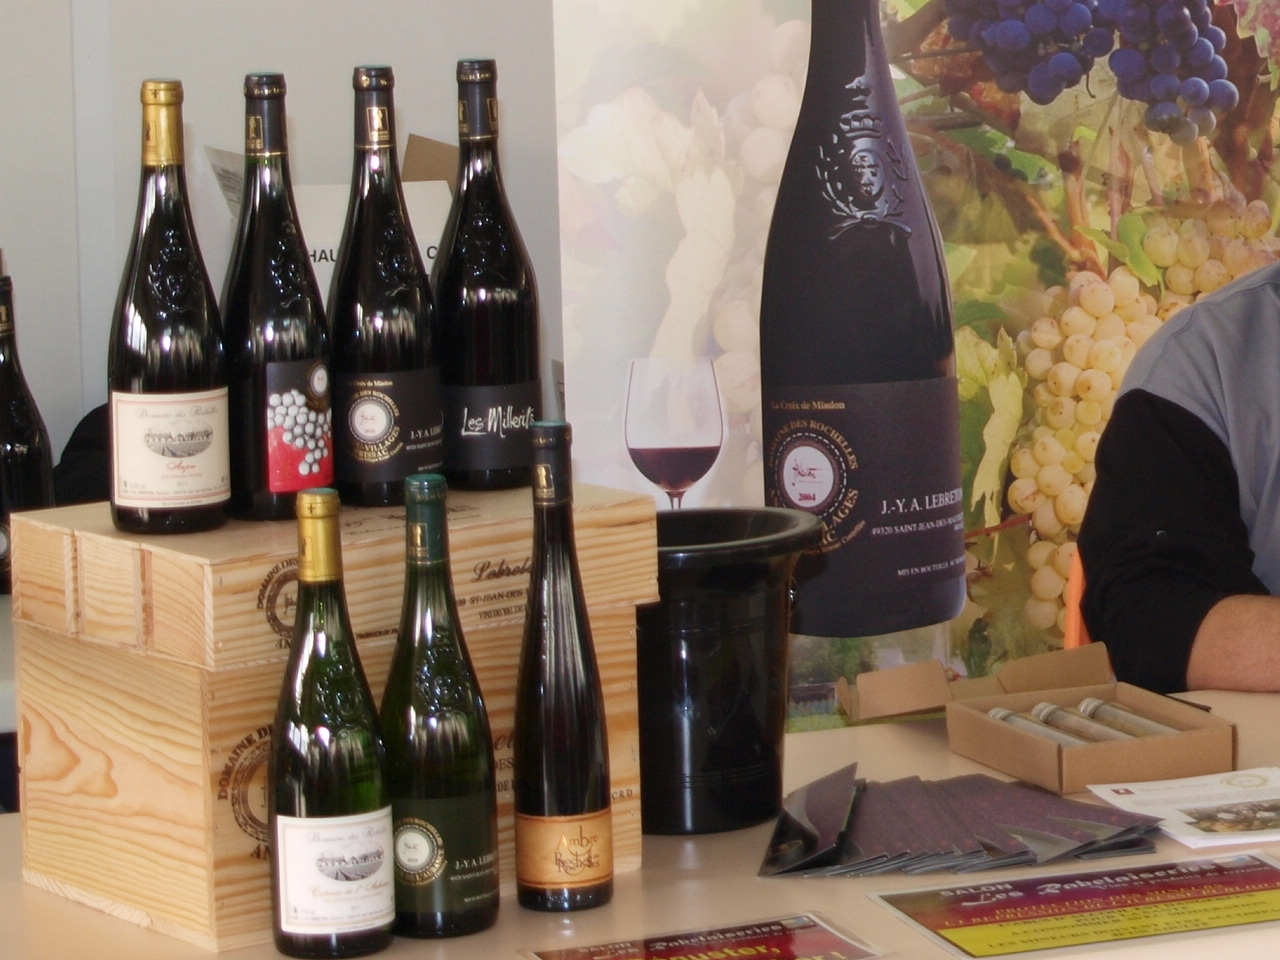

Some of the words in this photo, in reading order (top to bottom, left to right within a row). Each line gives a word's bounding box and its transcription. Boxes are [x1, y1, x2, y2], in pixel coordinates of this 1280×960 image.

[461, 406, 487, 436] Les
[812, 400, 846, 410] Mission
[809, 420, 858, 470] ROCHELLES
[217, 733, 257, 801] DOMAINE
[940, 883, 1013, 897] SALON
[962, 891, 1024, 906] Les
[1037, 865, 1217, 895] Rabelaiseries
